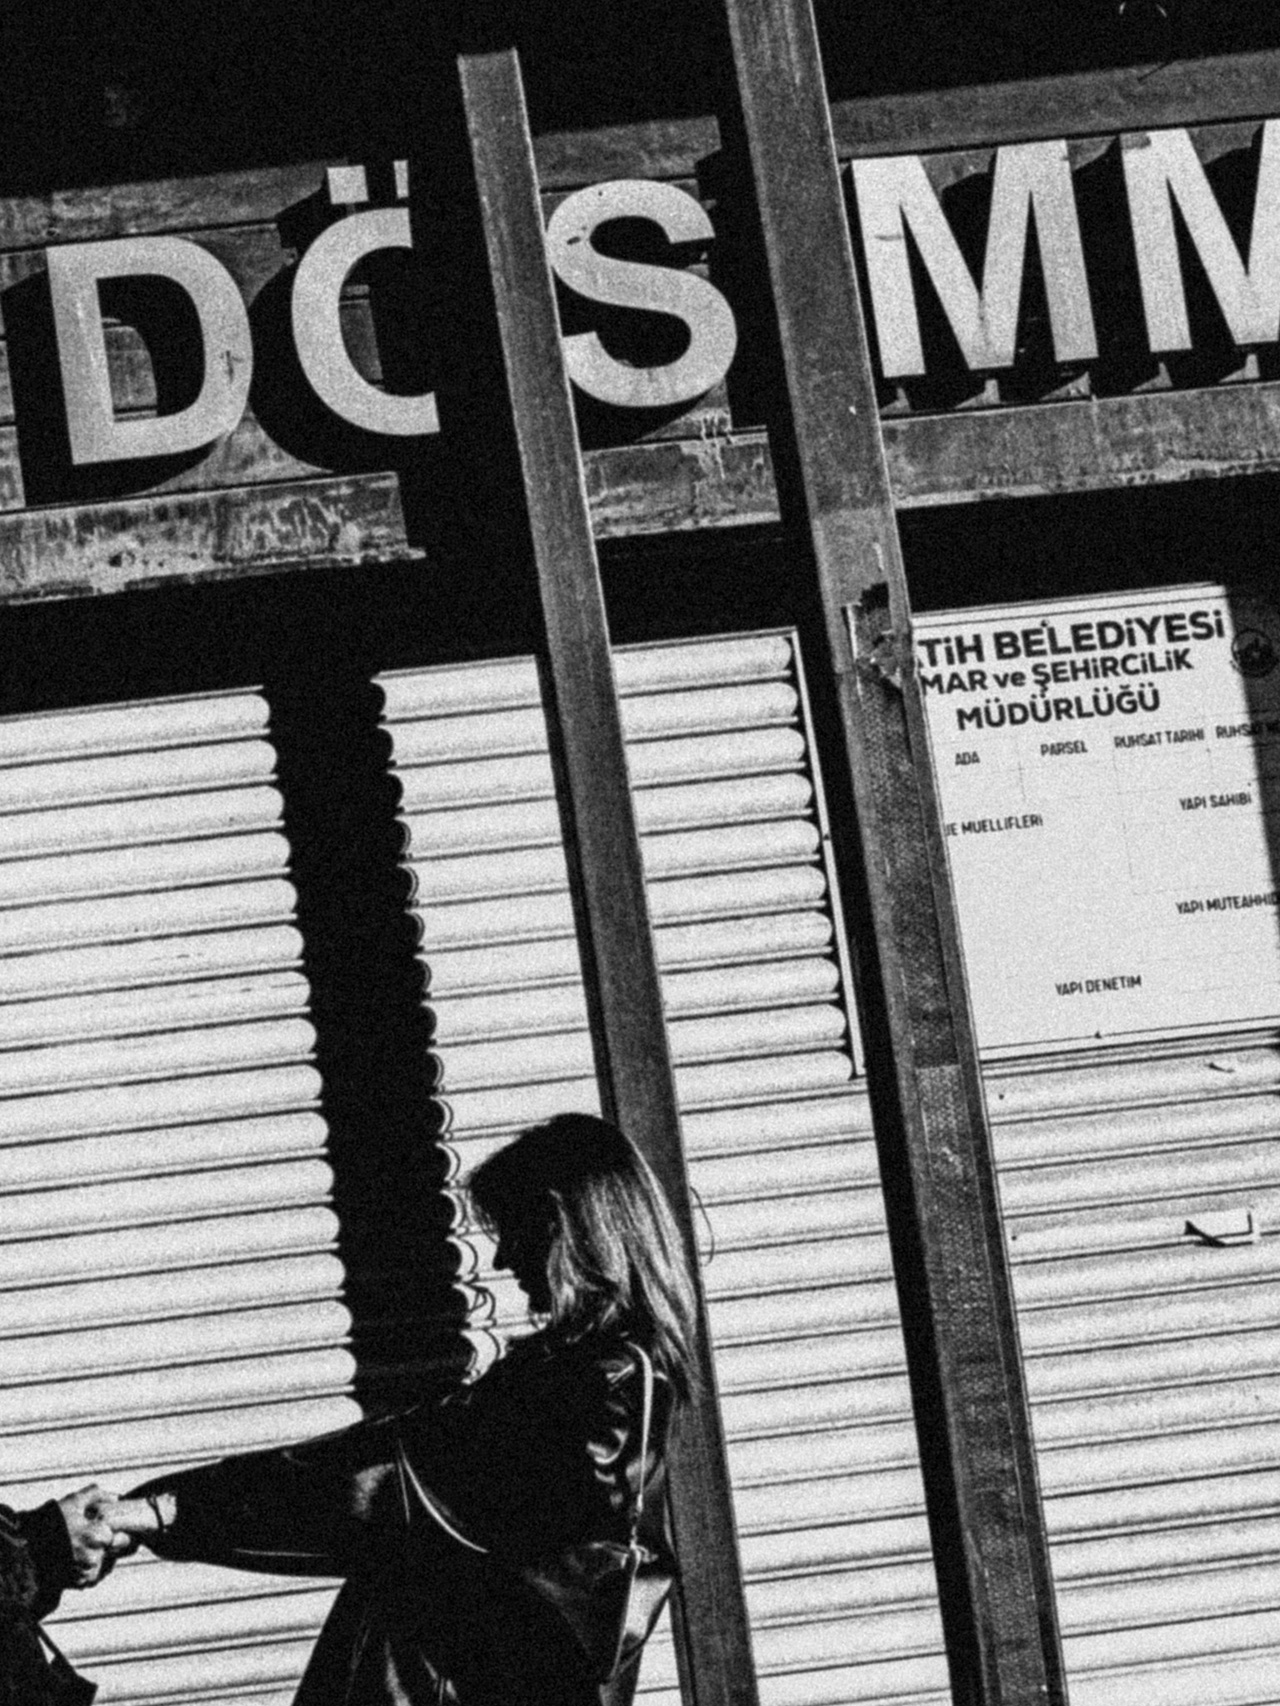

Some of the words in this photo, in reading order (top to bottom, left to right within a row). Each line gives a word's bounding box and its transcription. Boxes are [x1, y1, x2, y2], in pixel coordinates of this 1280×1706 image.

[916, 634, 985, 668] TİH
[993, 672, 1027, 690] ve
[956, 682, 1161, 731] MÜDÜRLÜĞÜ
[1040, 739, 1088, 757] PARSEL
[954, 750, 981, 766] ADA
